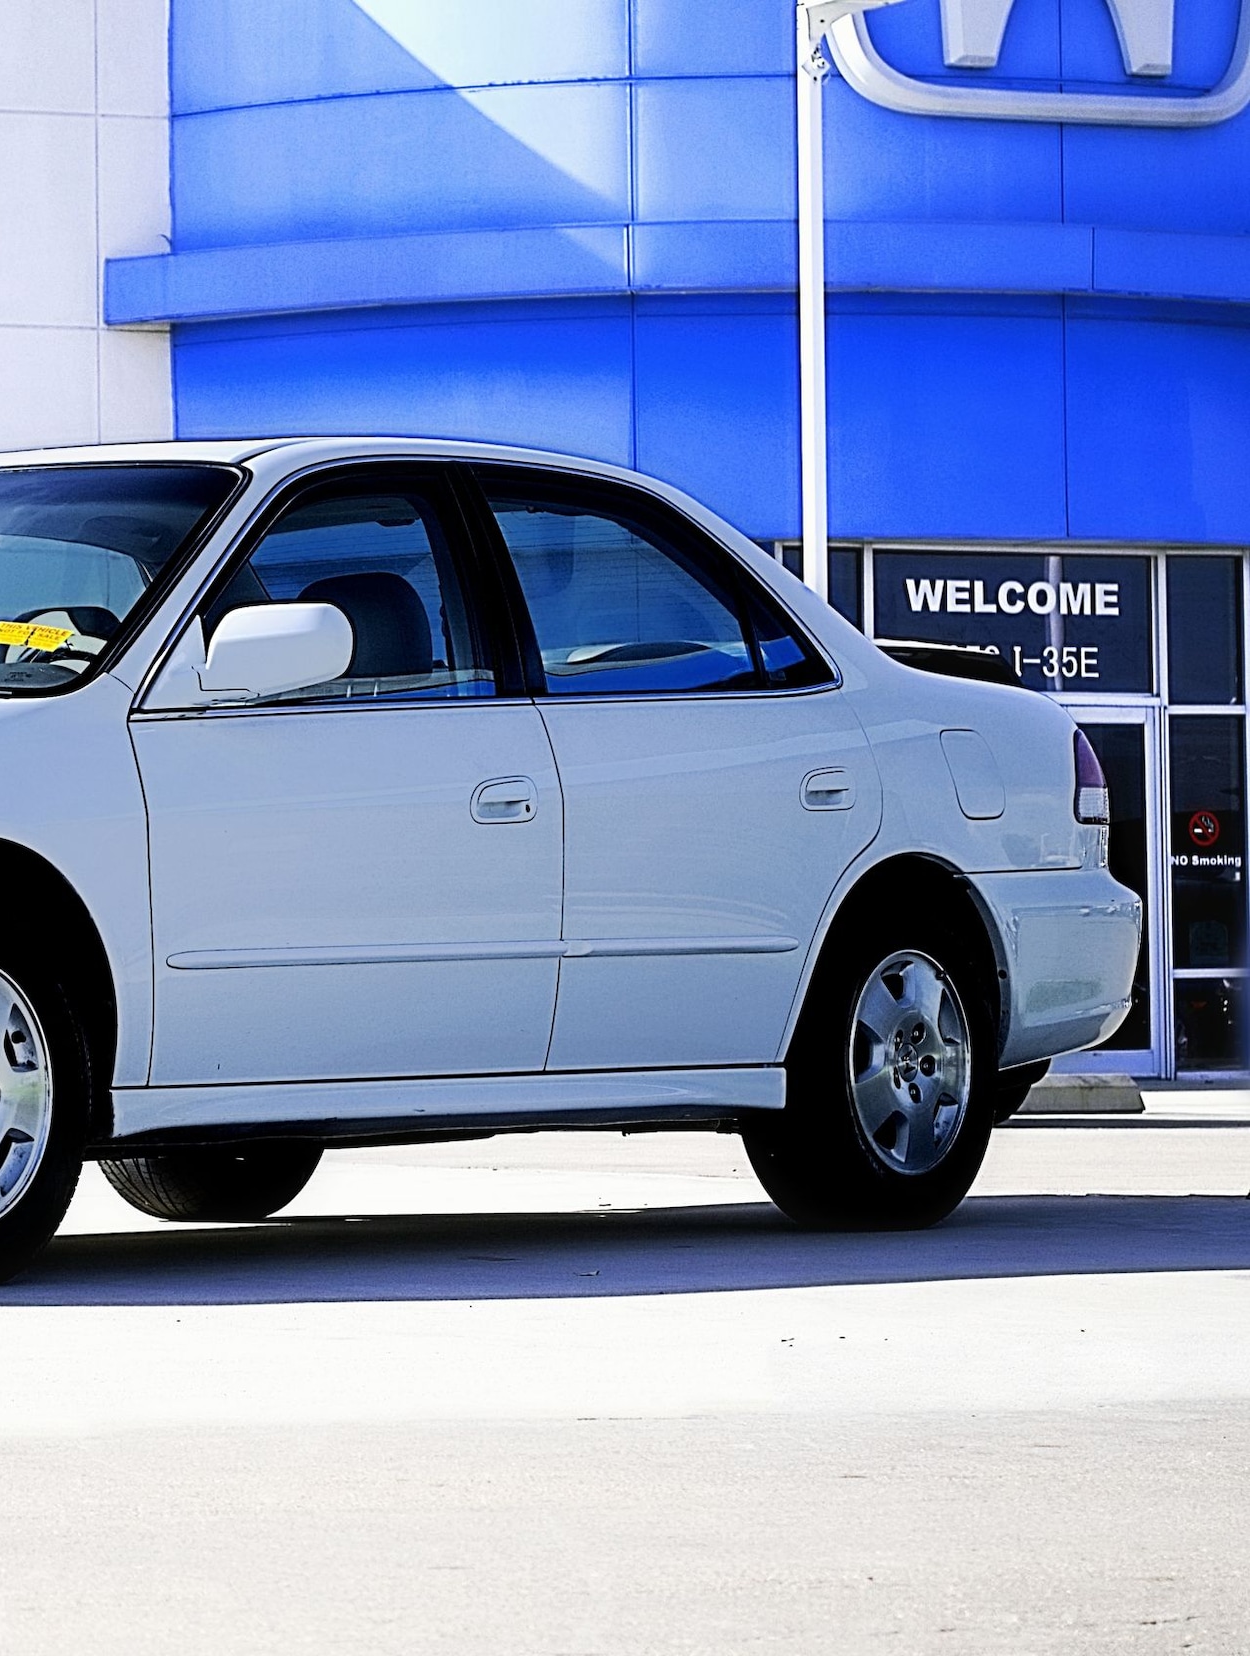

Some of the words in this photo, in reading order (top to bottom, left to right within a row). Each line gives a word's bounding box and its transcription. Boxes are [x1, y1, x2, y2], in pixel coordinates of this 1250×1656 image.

[906, 579, 1120, 616] WELCOME
[0, 622, 23, 631] THIS
[1013, 646, 1100, 677] I-35E
[1170, 855, 1188, 866] NO
[1192, 855, 1241, 867] Smoking
